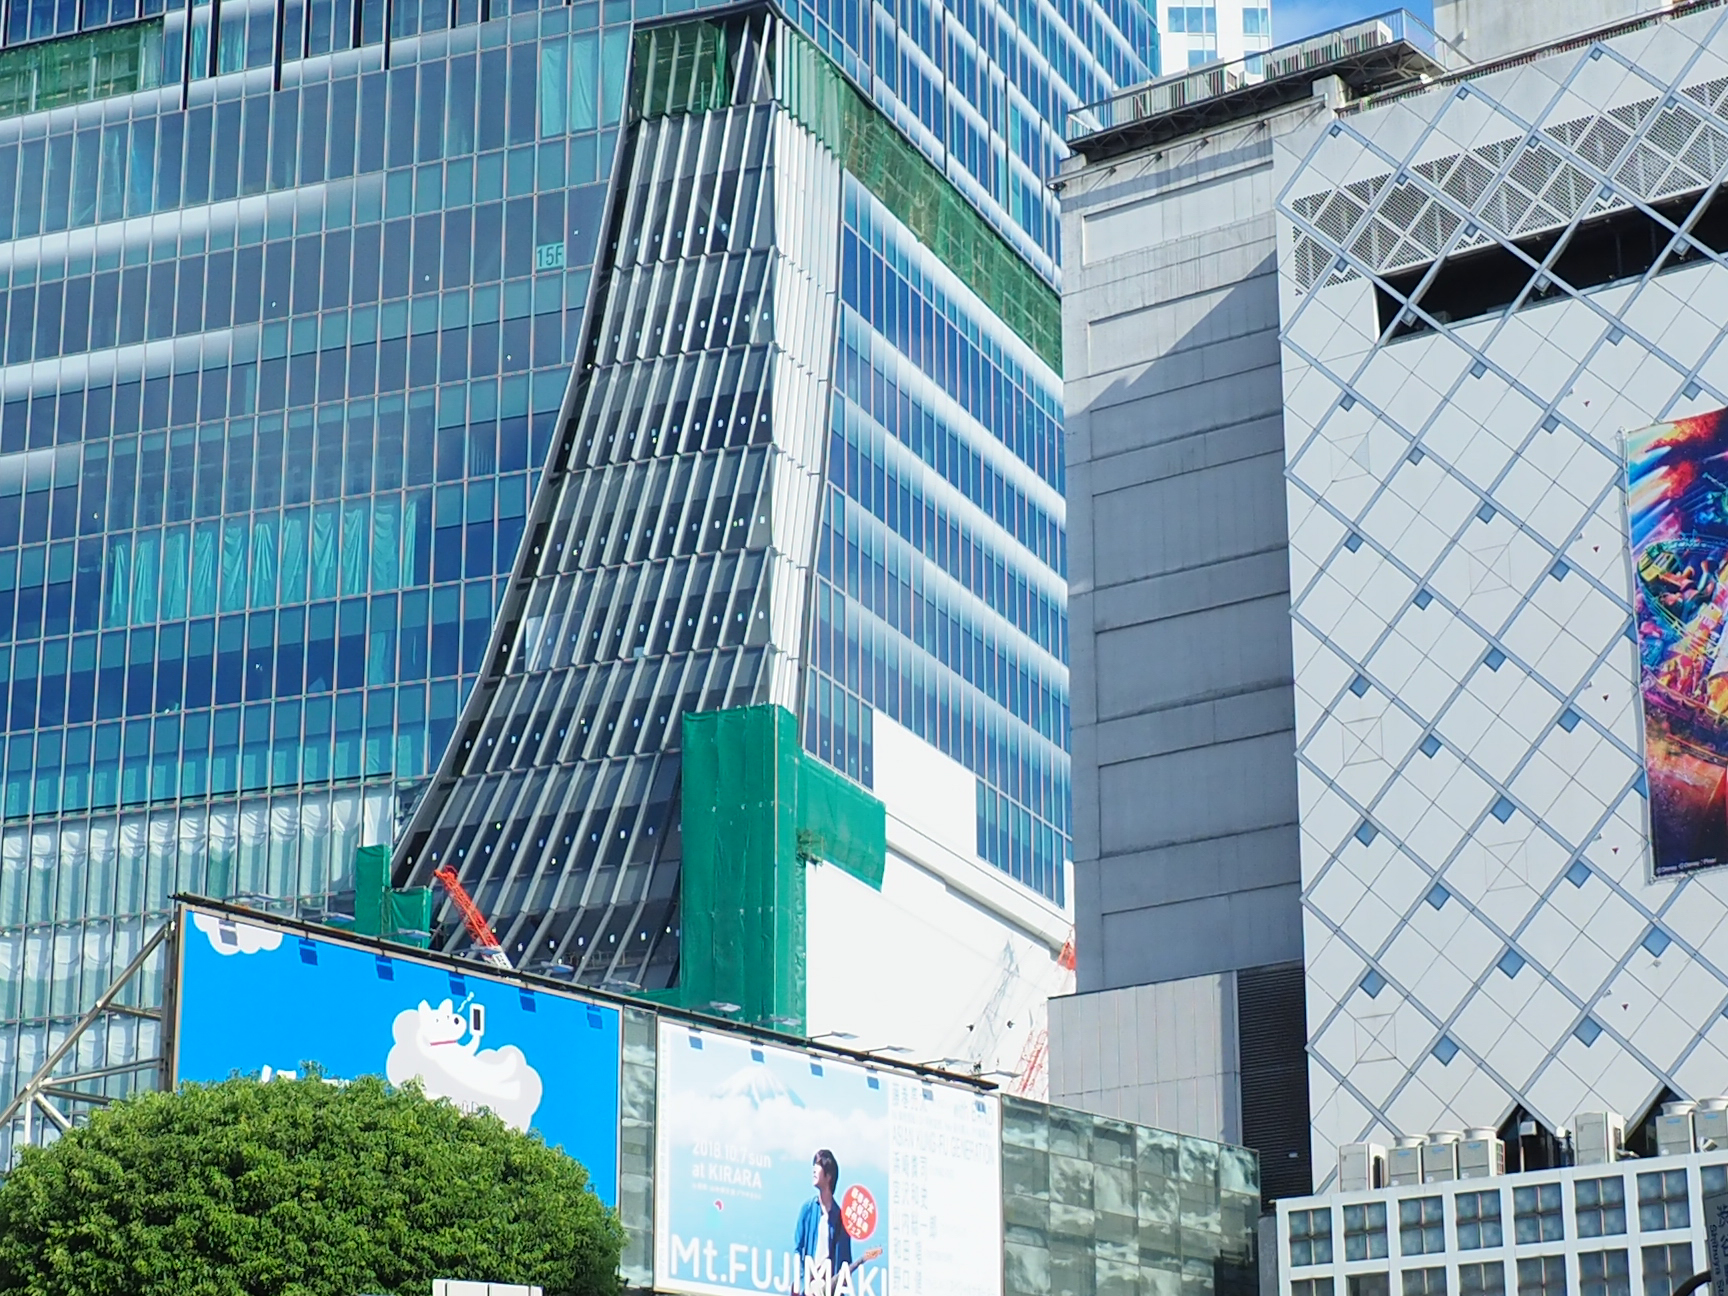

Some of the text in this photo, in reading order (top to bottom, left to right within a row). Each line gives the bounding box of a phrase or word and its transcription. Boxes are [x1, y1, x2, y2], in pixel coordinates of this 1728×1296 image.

[748, 1152, 772, 1169] sun
[692, 1162, 763, 1190] at KIRARA
